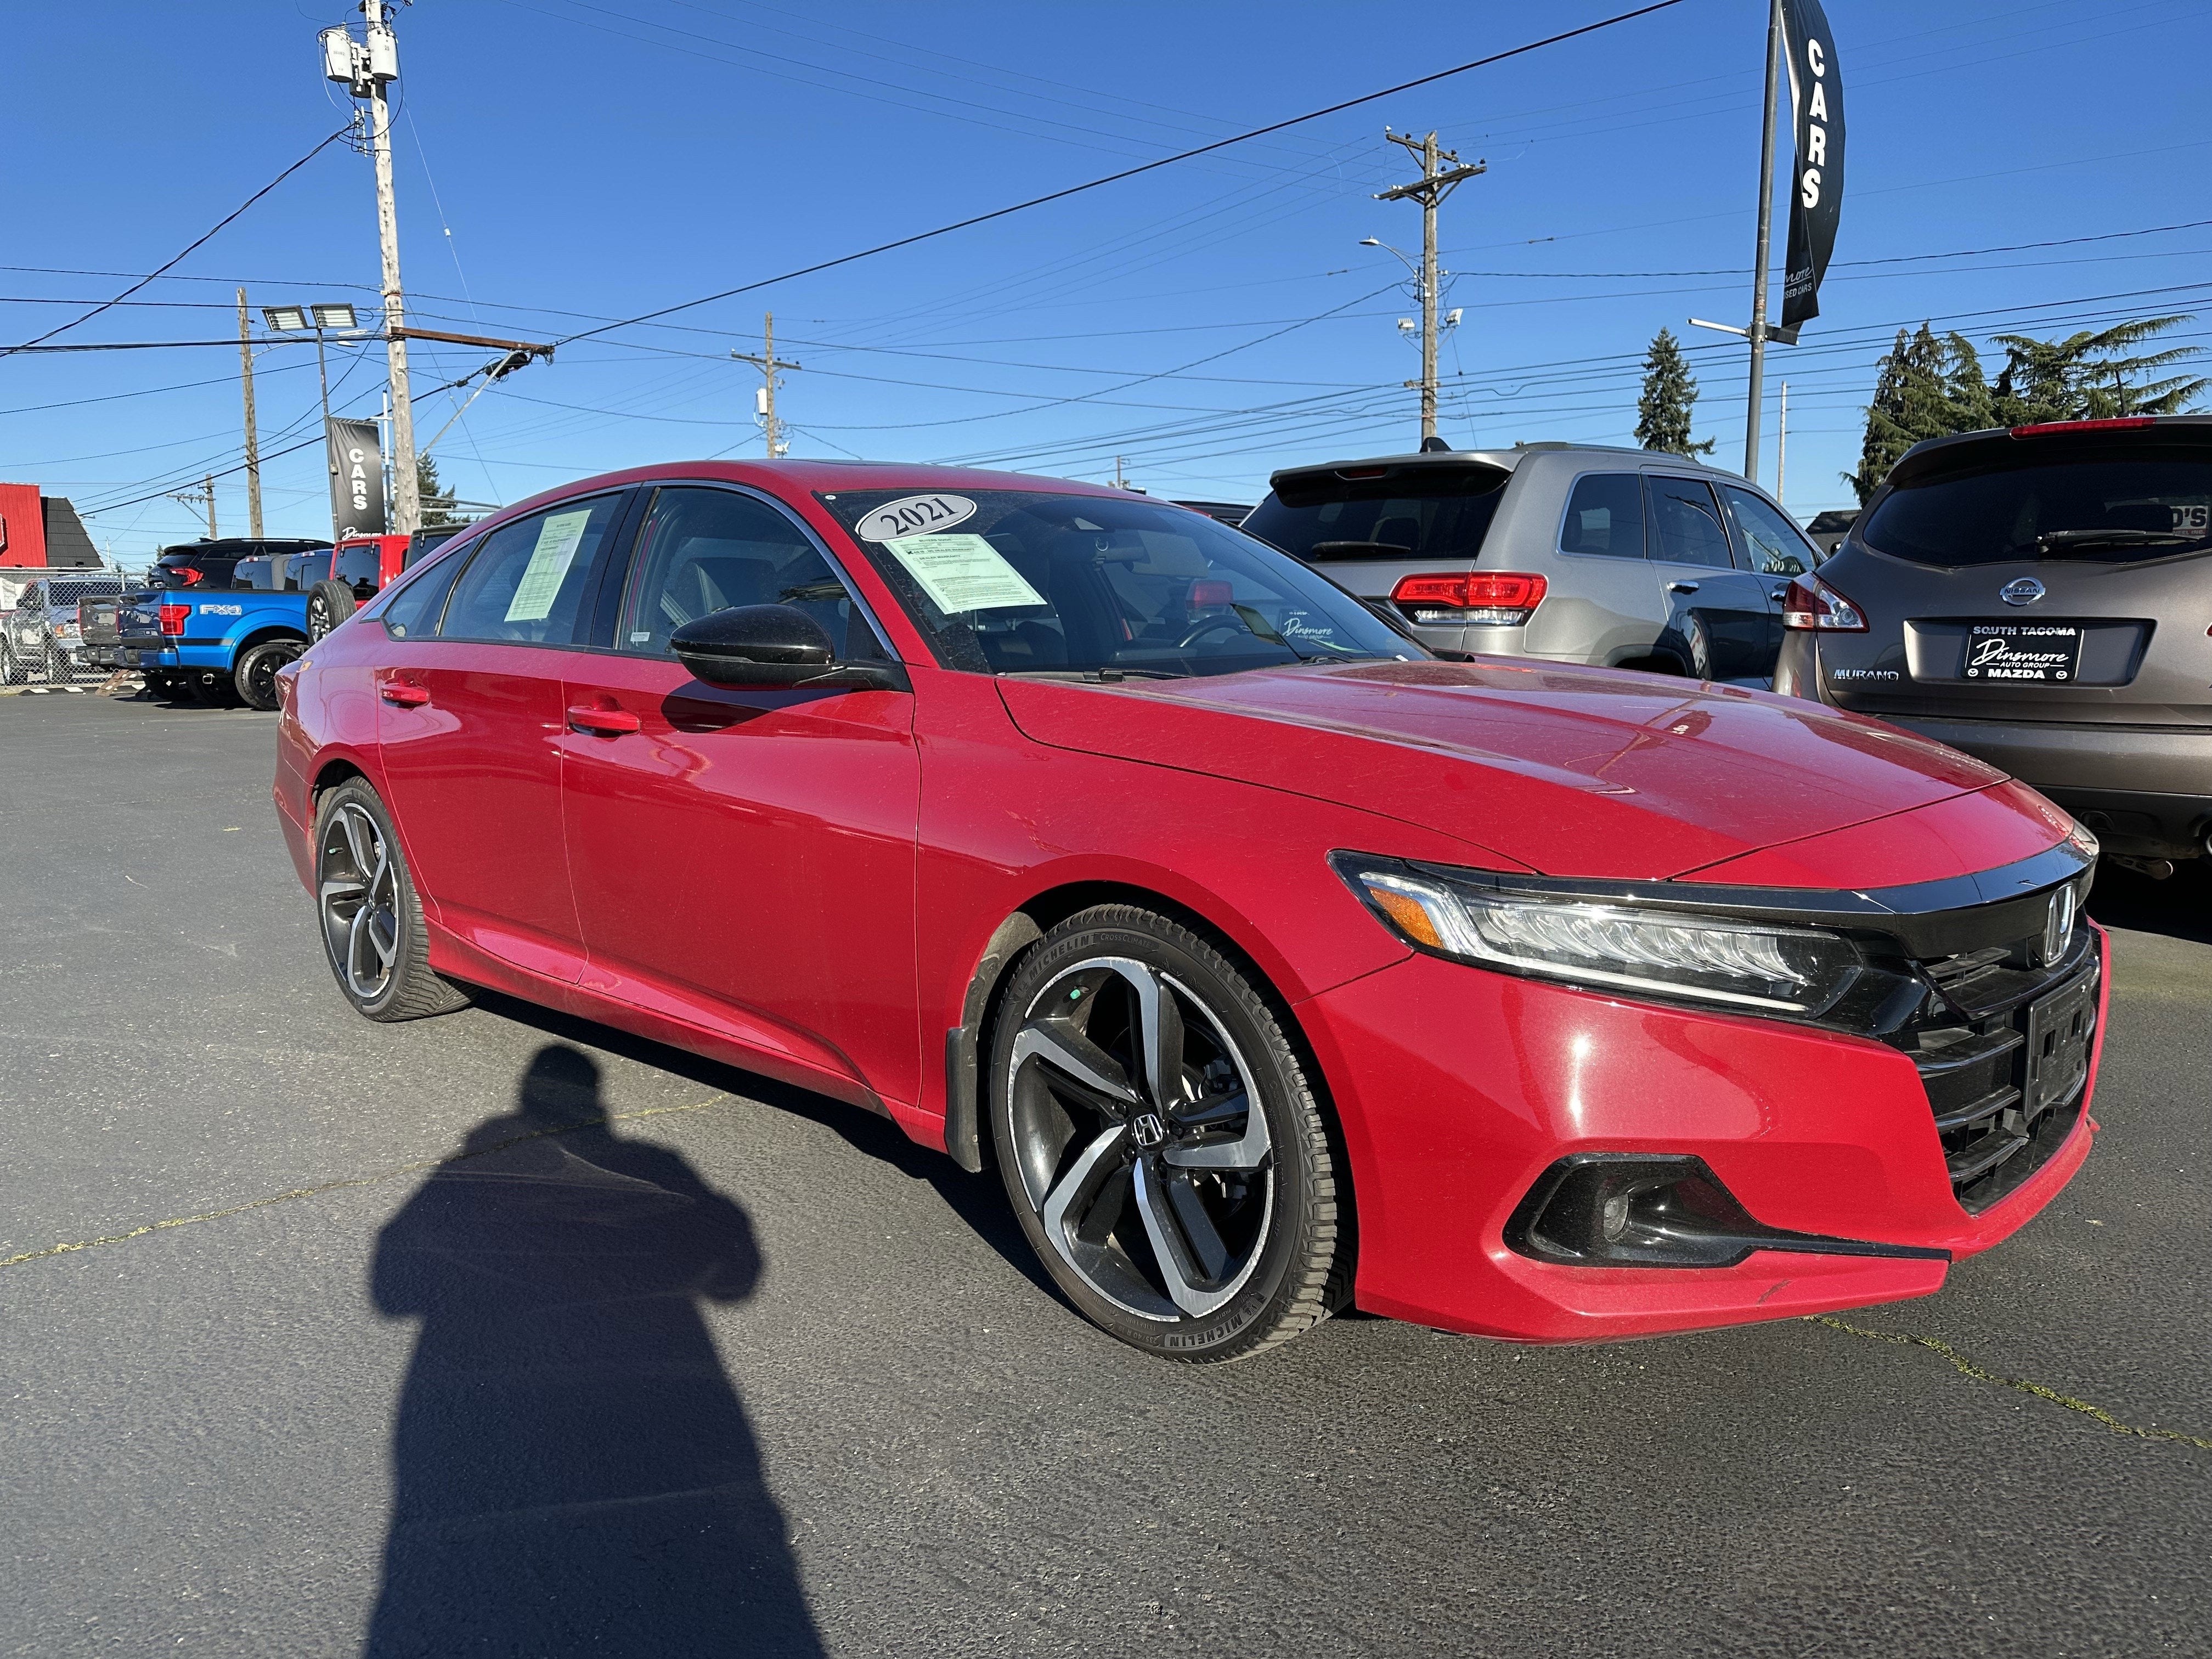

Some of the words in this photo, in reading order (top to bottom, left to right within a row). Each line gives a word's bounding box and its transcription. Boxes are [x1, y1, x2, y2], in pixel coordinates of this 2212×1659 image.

[1802, 38, 1828, 209] CARS
[1798, 283, 1812, 295] CARS
[349, 448, 368, 510] CARS
[880, 497, 960, 535] 2021
[199, 604, 242, 615] FX4
[1283, 618, 1333, 636] Dinsmore
[1973, 626, 2017, 635] SOUTH
[2021, 627, 2076, 636] TACOMA
[1971, 639, 2069, 665] Dinsmore
[1833, 669, 1899, 681] MURANO
[1988, 668, 2045, 679] MAZDA
[1029, 934, 1092, 981] MICHELIN
[1169, 1314, 1243, 1347] MICHELIN
